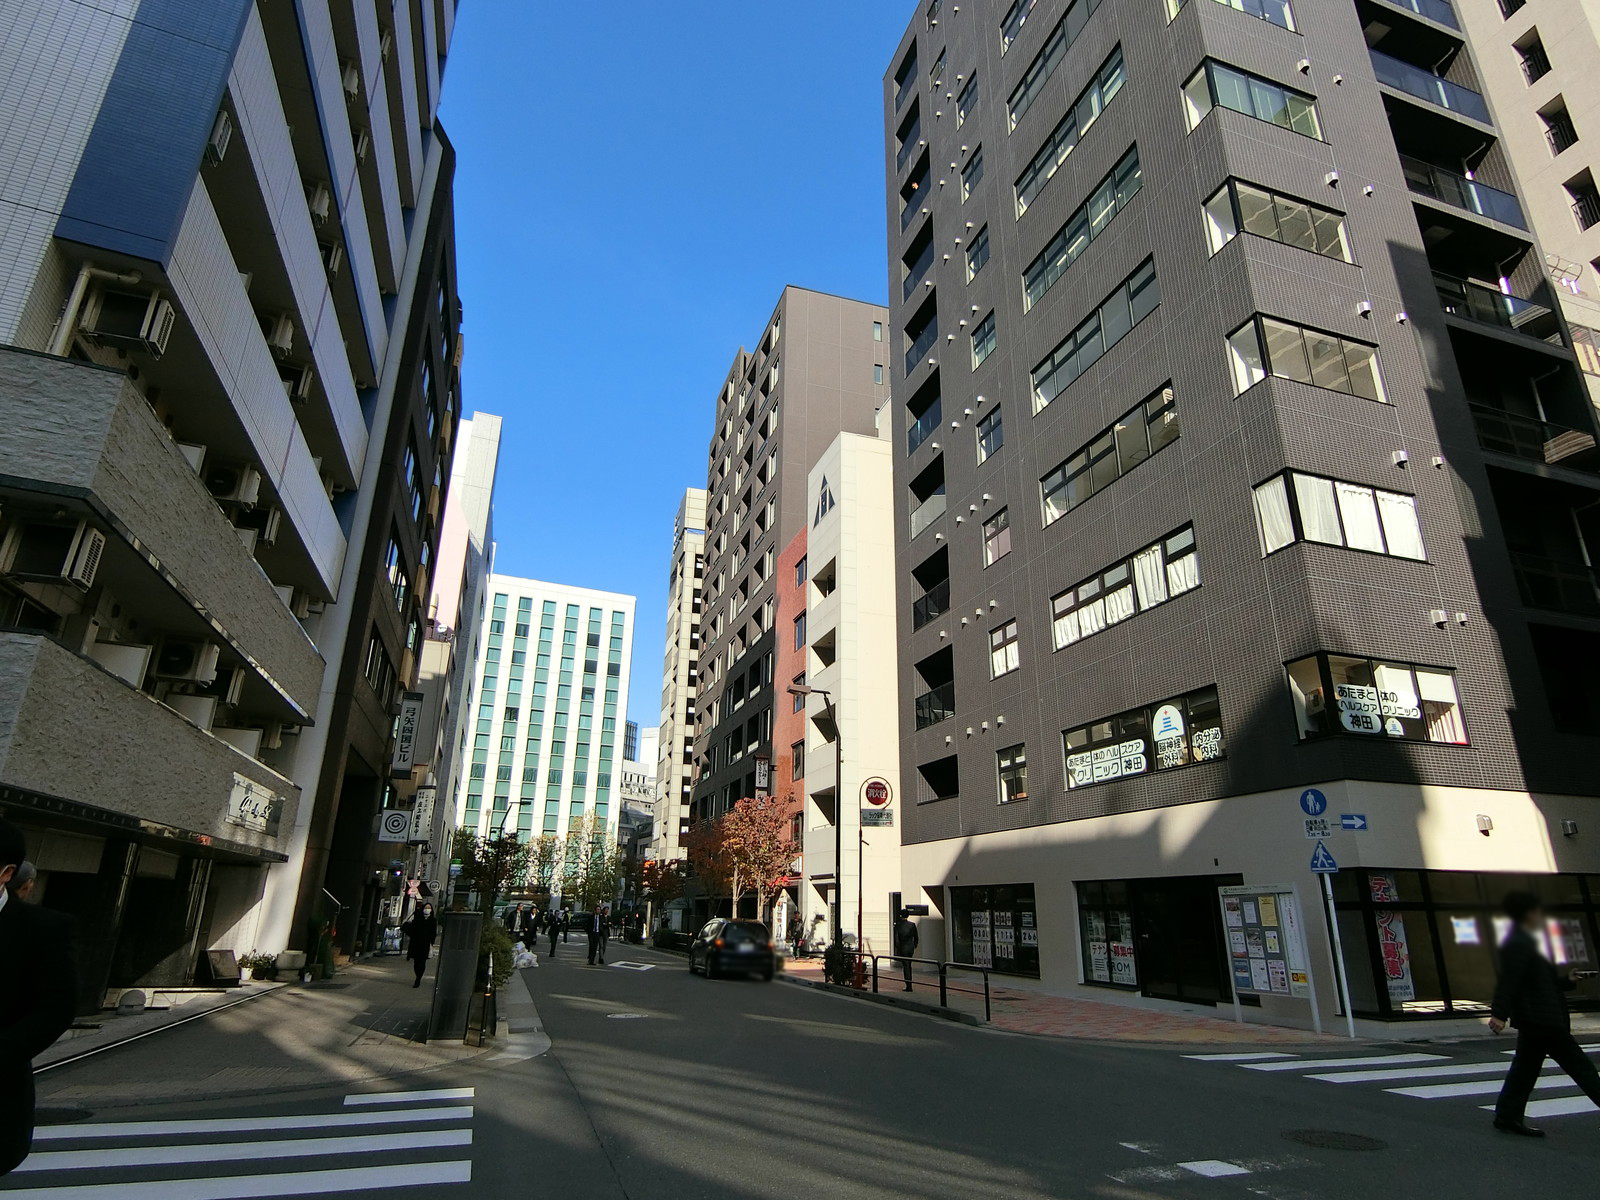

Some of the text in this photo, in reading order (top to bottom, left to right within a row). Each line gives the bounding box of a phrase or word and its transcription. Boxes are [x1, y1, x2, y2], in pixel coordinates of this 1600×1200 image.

[1340, 701, 1420, 717] ヘルスケアクリニック
[1348, 713, 1375, 730] 神田
[397, 706, 417, 763] 弓矢四国ビル
[1194, 728, 1222, 743] 内分泌
[1158, 737, 1183, 753] 脳神経
[1200, 743, 1219, 757] 内科
[1163, 752, 1180, 765] 外科
